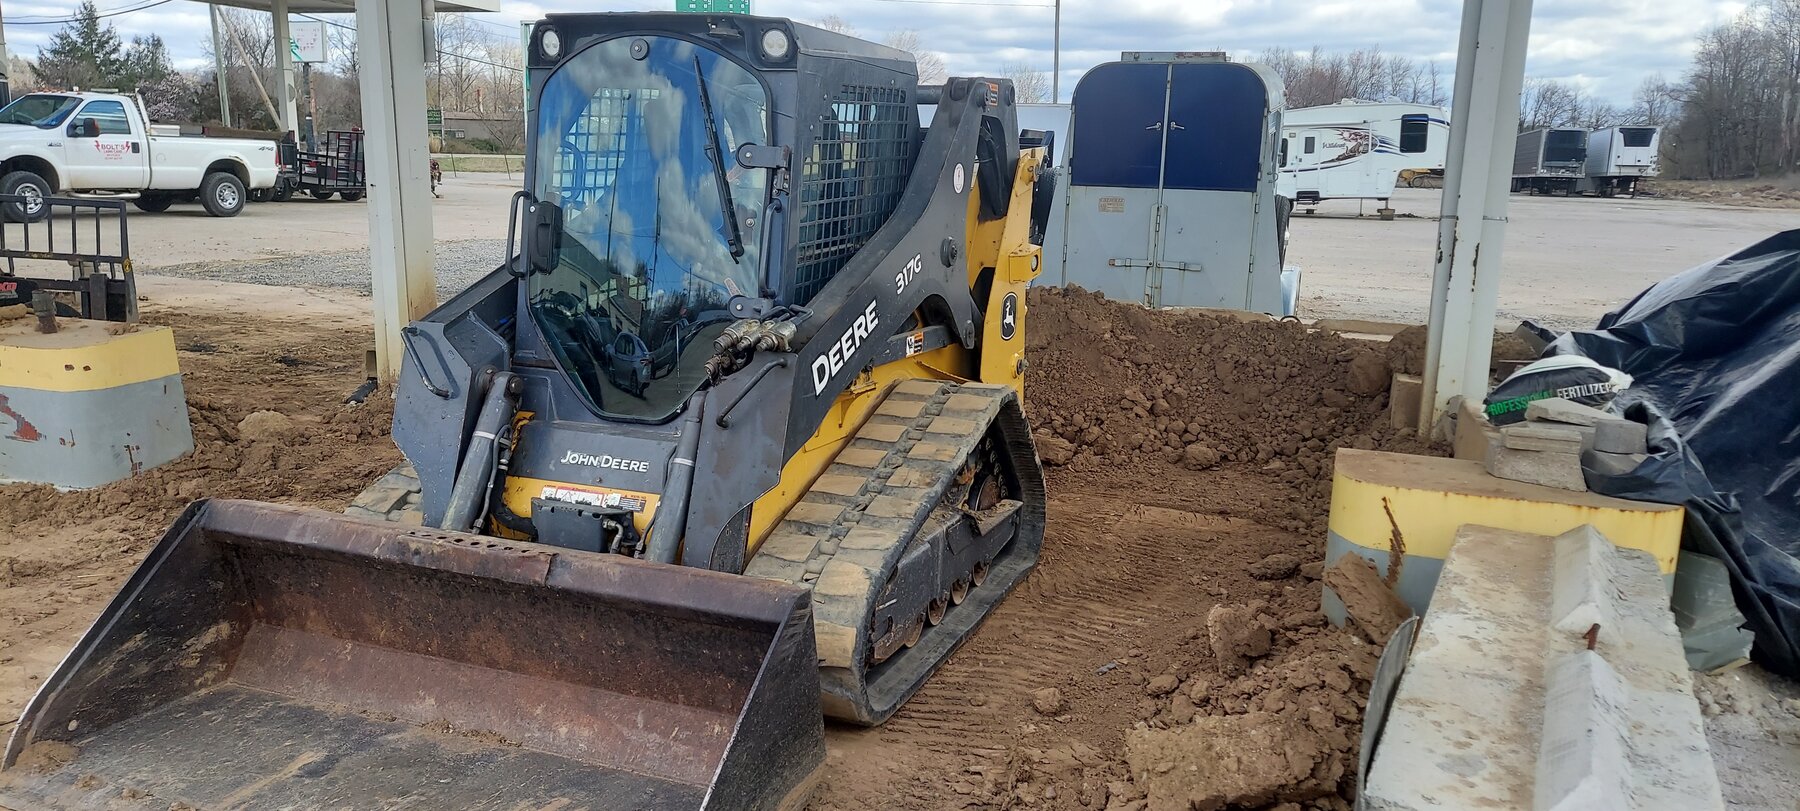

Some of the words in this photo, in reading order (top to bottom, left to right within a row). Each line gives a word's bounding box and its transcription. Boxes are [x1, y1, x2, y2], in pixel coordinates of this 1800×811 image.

[895, 253, 922, 295] 317G
[812, 300, 878, 396] DEERE
[1557, 382, 1612, 399] FERTILIZER
[561, 451, 598, 467] JOHN
[601, 455, 649, 472] DEERE
